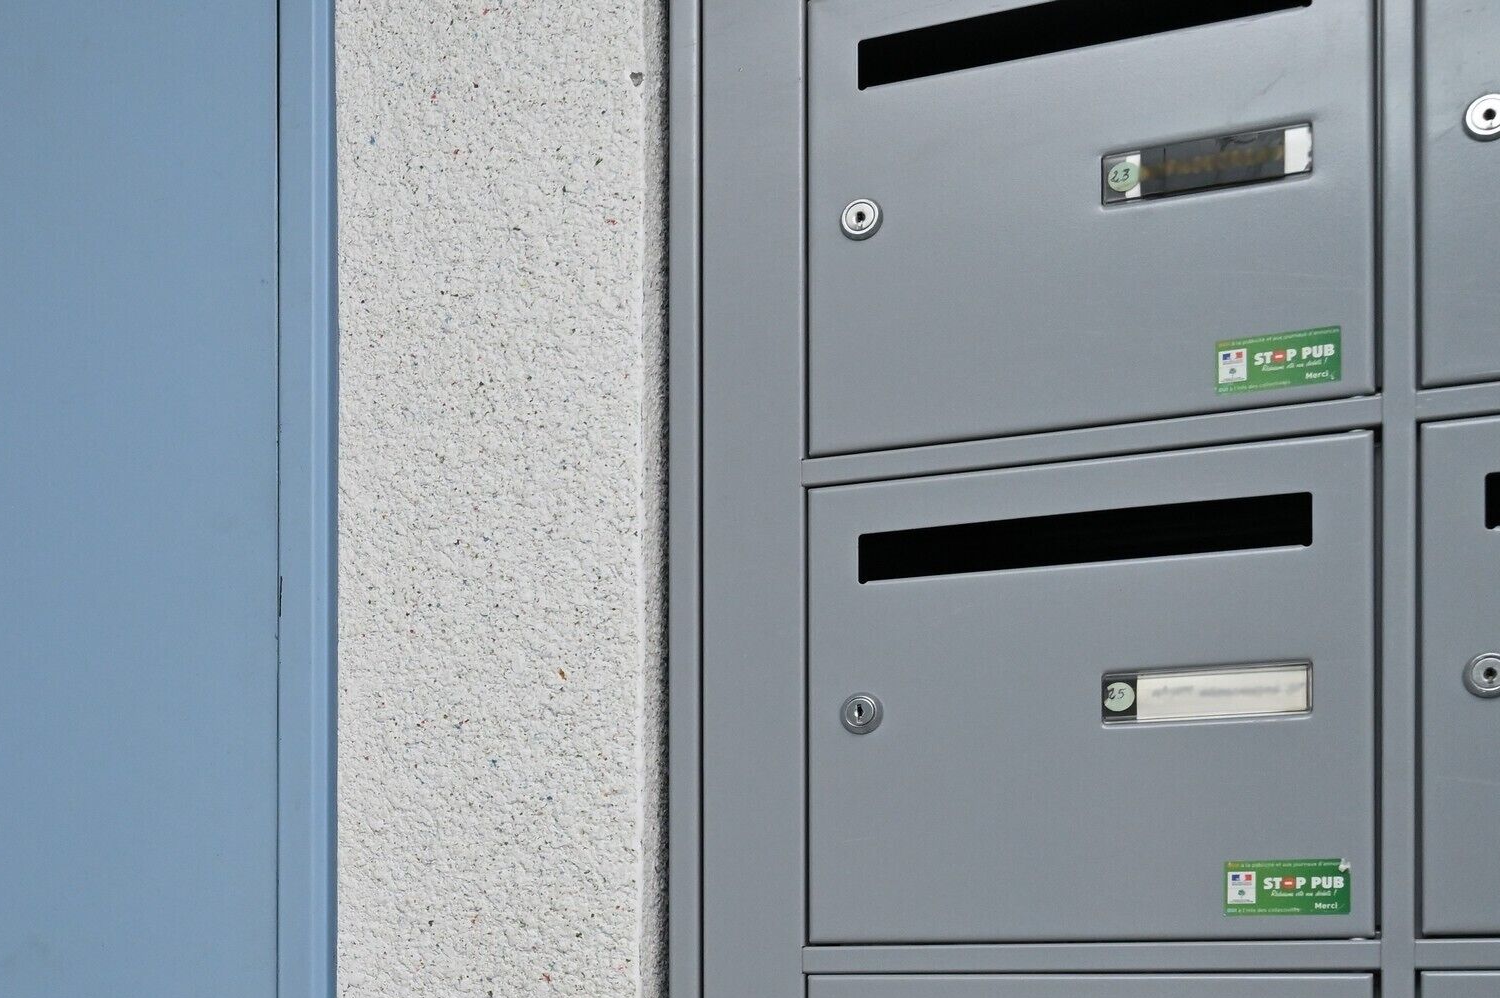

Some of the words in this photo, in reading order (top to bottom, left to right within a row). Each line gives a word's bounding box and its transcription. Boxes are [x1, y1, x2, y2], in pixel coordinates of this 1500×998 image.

[1110, 168, 1130, 183] 23
[1254, 347, 1297, 365] STOP
[1302, 343, 1335, 359] PUB
[1305, 370, 1329, 380] Merci
[1109, 688, 1126, 700] 25
[1263, 876, 1306, 890] STOP
[1311, 876, 1344, 889] PUB
[1314, 902, 1338, 910] Merci
